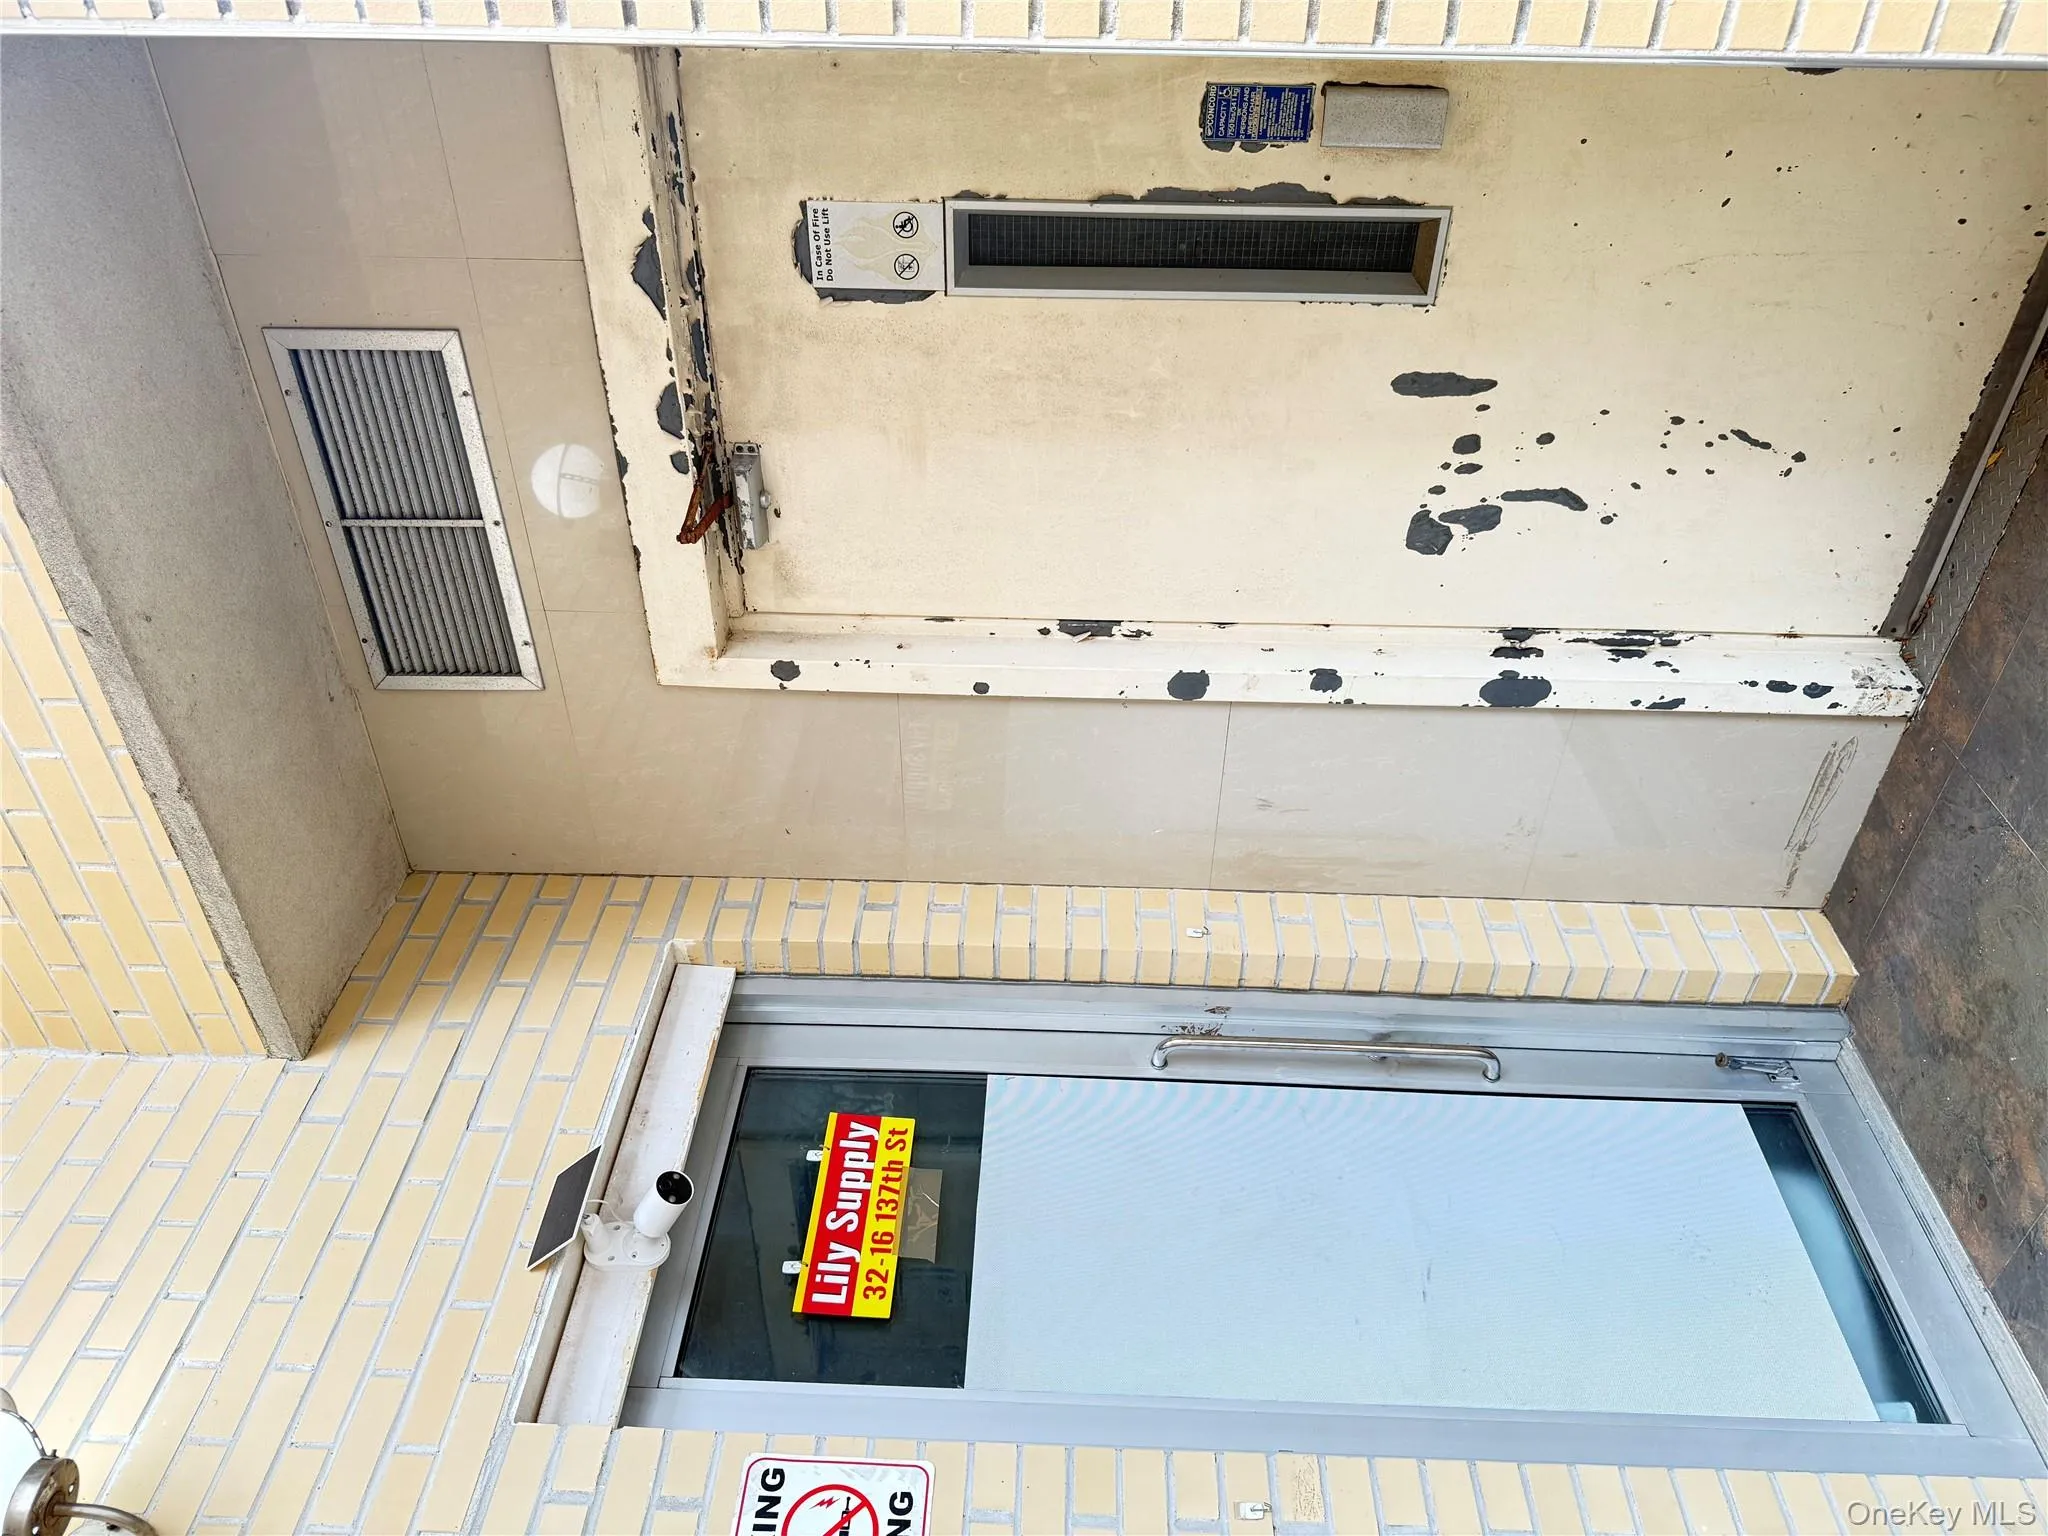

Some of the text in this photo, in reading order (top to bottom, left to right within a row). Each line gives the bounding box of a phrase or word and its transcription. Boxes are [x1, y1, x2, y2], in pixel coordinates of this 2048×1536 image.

[1207, 85, 1217, 125] CONCORD
[1218, 100, 1227, 137] CAPACITY
[1240, 102, 1249, 134] PERSONS
[1247, 91, 1256, 135] WHEELCHAIR
[812, 208, 824, 281] In Case Of Fire
[821, 207, 834, 281] Do Not Use Lift
[811, 1121, 880, 1305] Lily Supply
[863, 1127, 909, 1300] 32-16 137th St
[750, 1468, 786, 1536] ING
